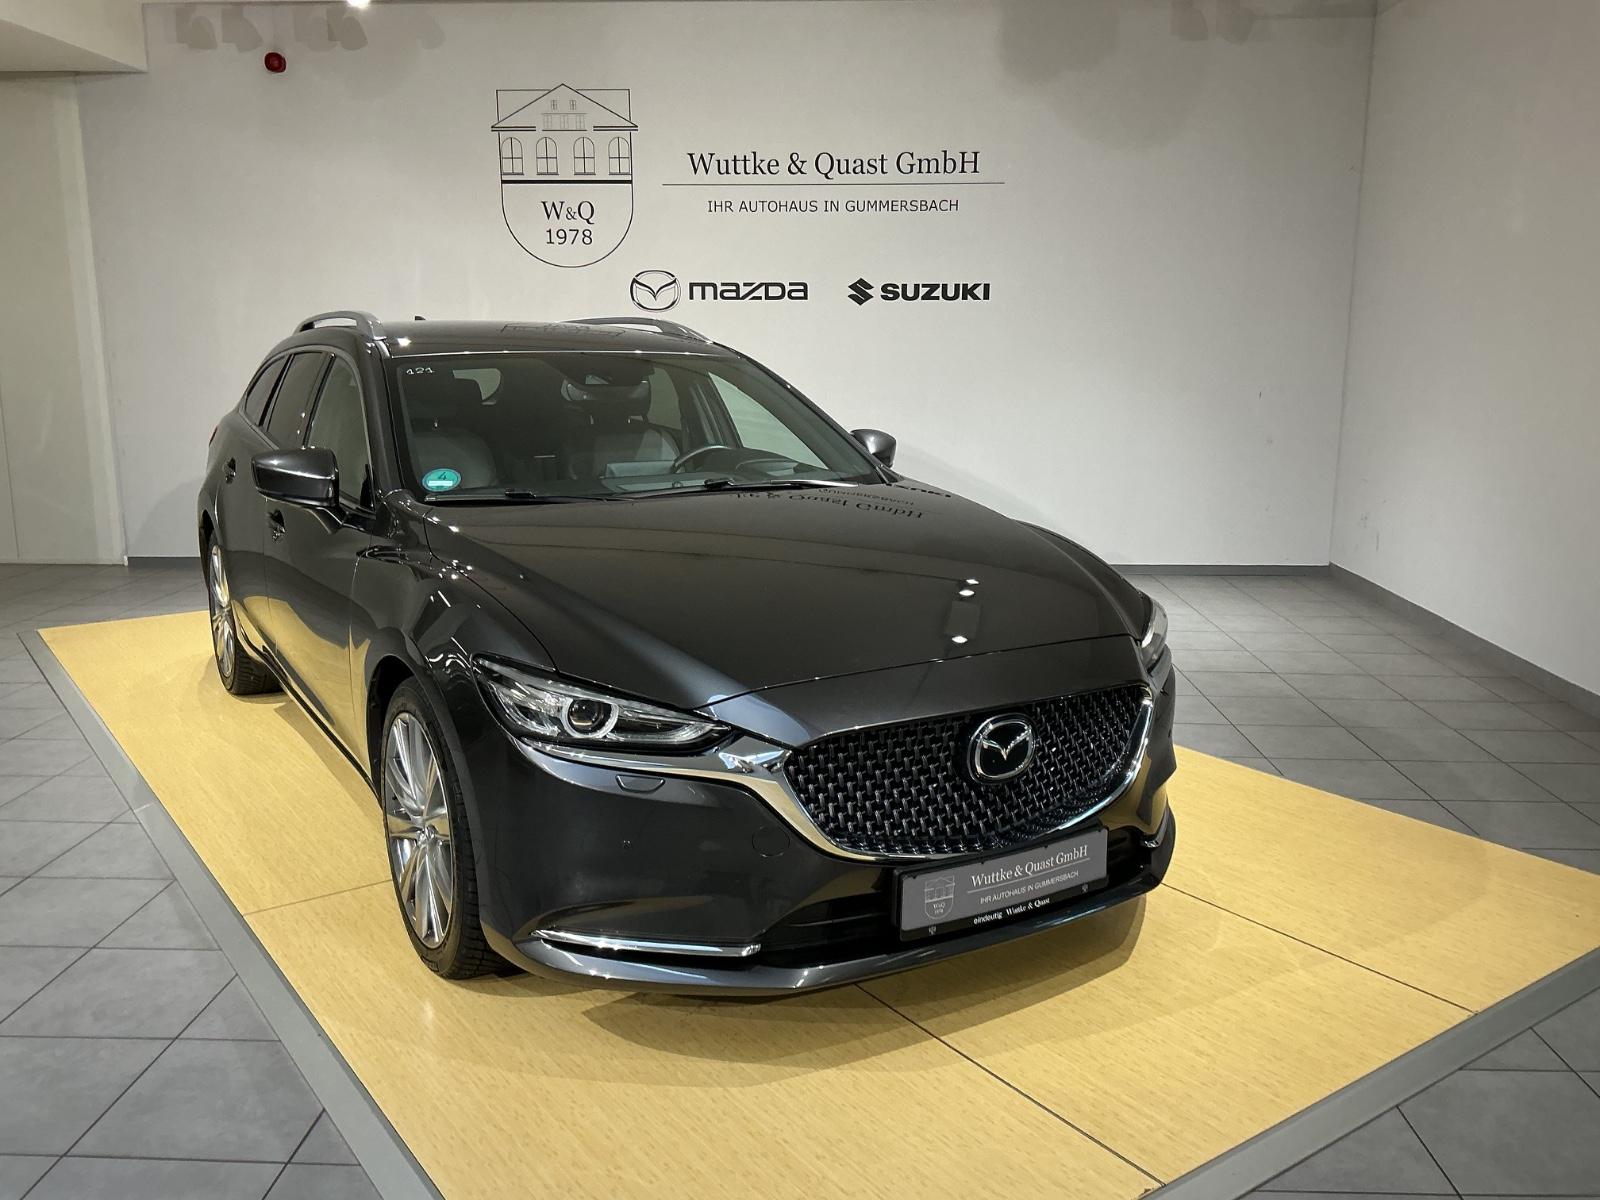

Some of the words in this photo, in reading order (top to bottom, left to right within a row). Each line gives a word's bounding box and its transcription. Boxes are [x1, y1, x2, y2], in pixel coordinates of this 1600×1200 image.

[688, 152, 780, 176] Wuttke
[788, 152, 808, 176] &
[815, 152, 889, 180] Quast
[896, 149, 981, 175] GmbH
[541, 200, 595, 225] W&Q
[707, 200, 734, 213] IHR
[738, 200, 818, 213] AUTOHAUS
[825, 200, 840, 213] IN
[846, 199, 959, 213] GUMMERSBACH
[546, 228, 593, 246] 1978
[880, 282, 991, 302] SUZUKI
[438, 471, 447, 480] 4
[971, 869, 1013, 887] Wuttke
[1014, 866, 1024, 877] &
[1025, 857, 1055, 875] Quast
[1056, 845, 1088, 865] GmbH
[980, 896, 993, 905] IHR
[992, 885, 1027, 903] AUTOHAUS
[1027, 883, 1035, 893] IN
[1034, 870, 1079, 890] GUMMERSBACH
[973, 911, 1003, 925] eindeutig
[1005, 904, 1027, 916] Wuttke
[1027, 901, 1034, 910] &
[1034, 897, 1050, 908] Quast
